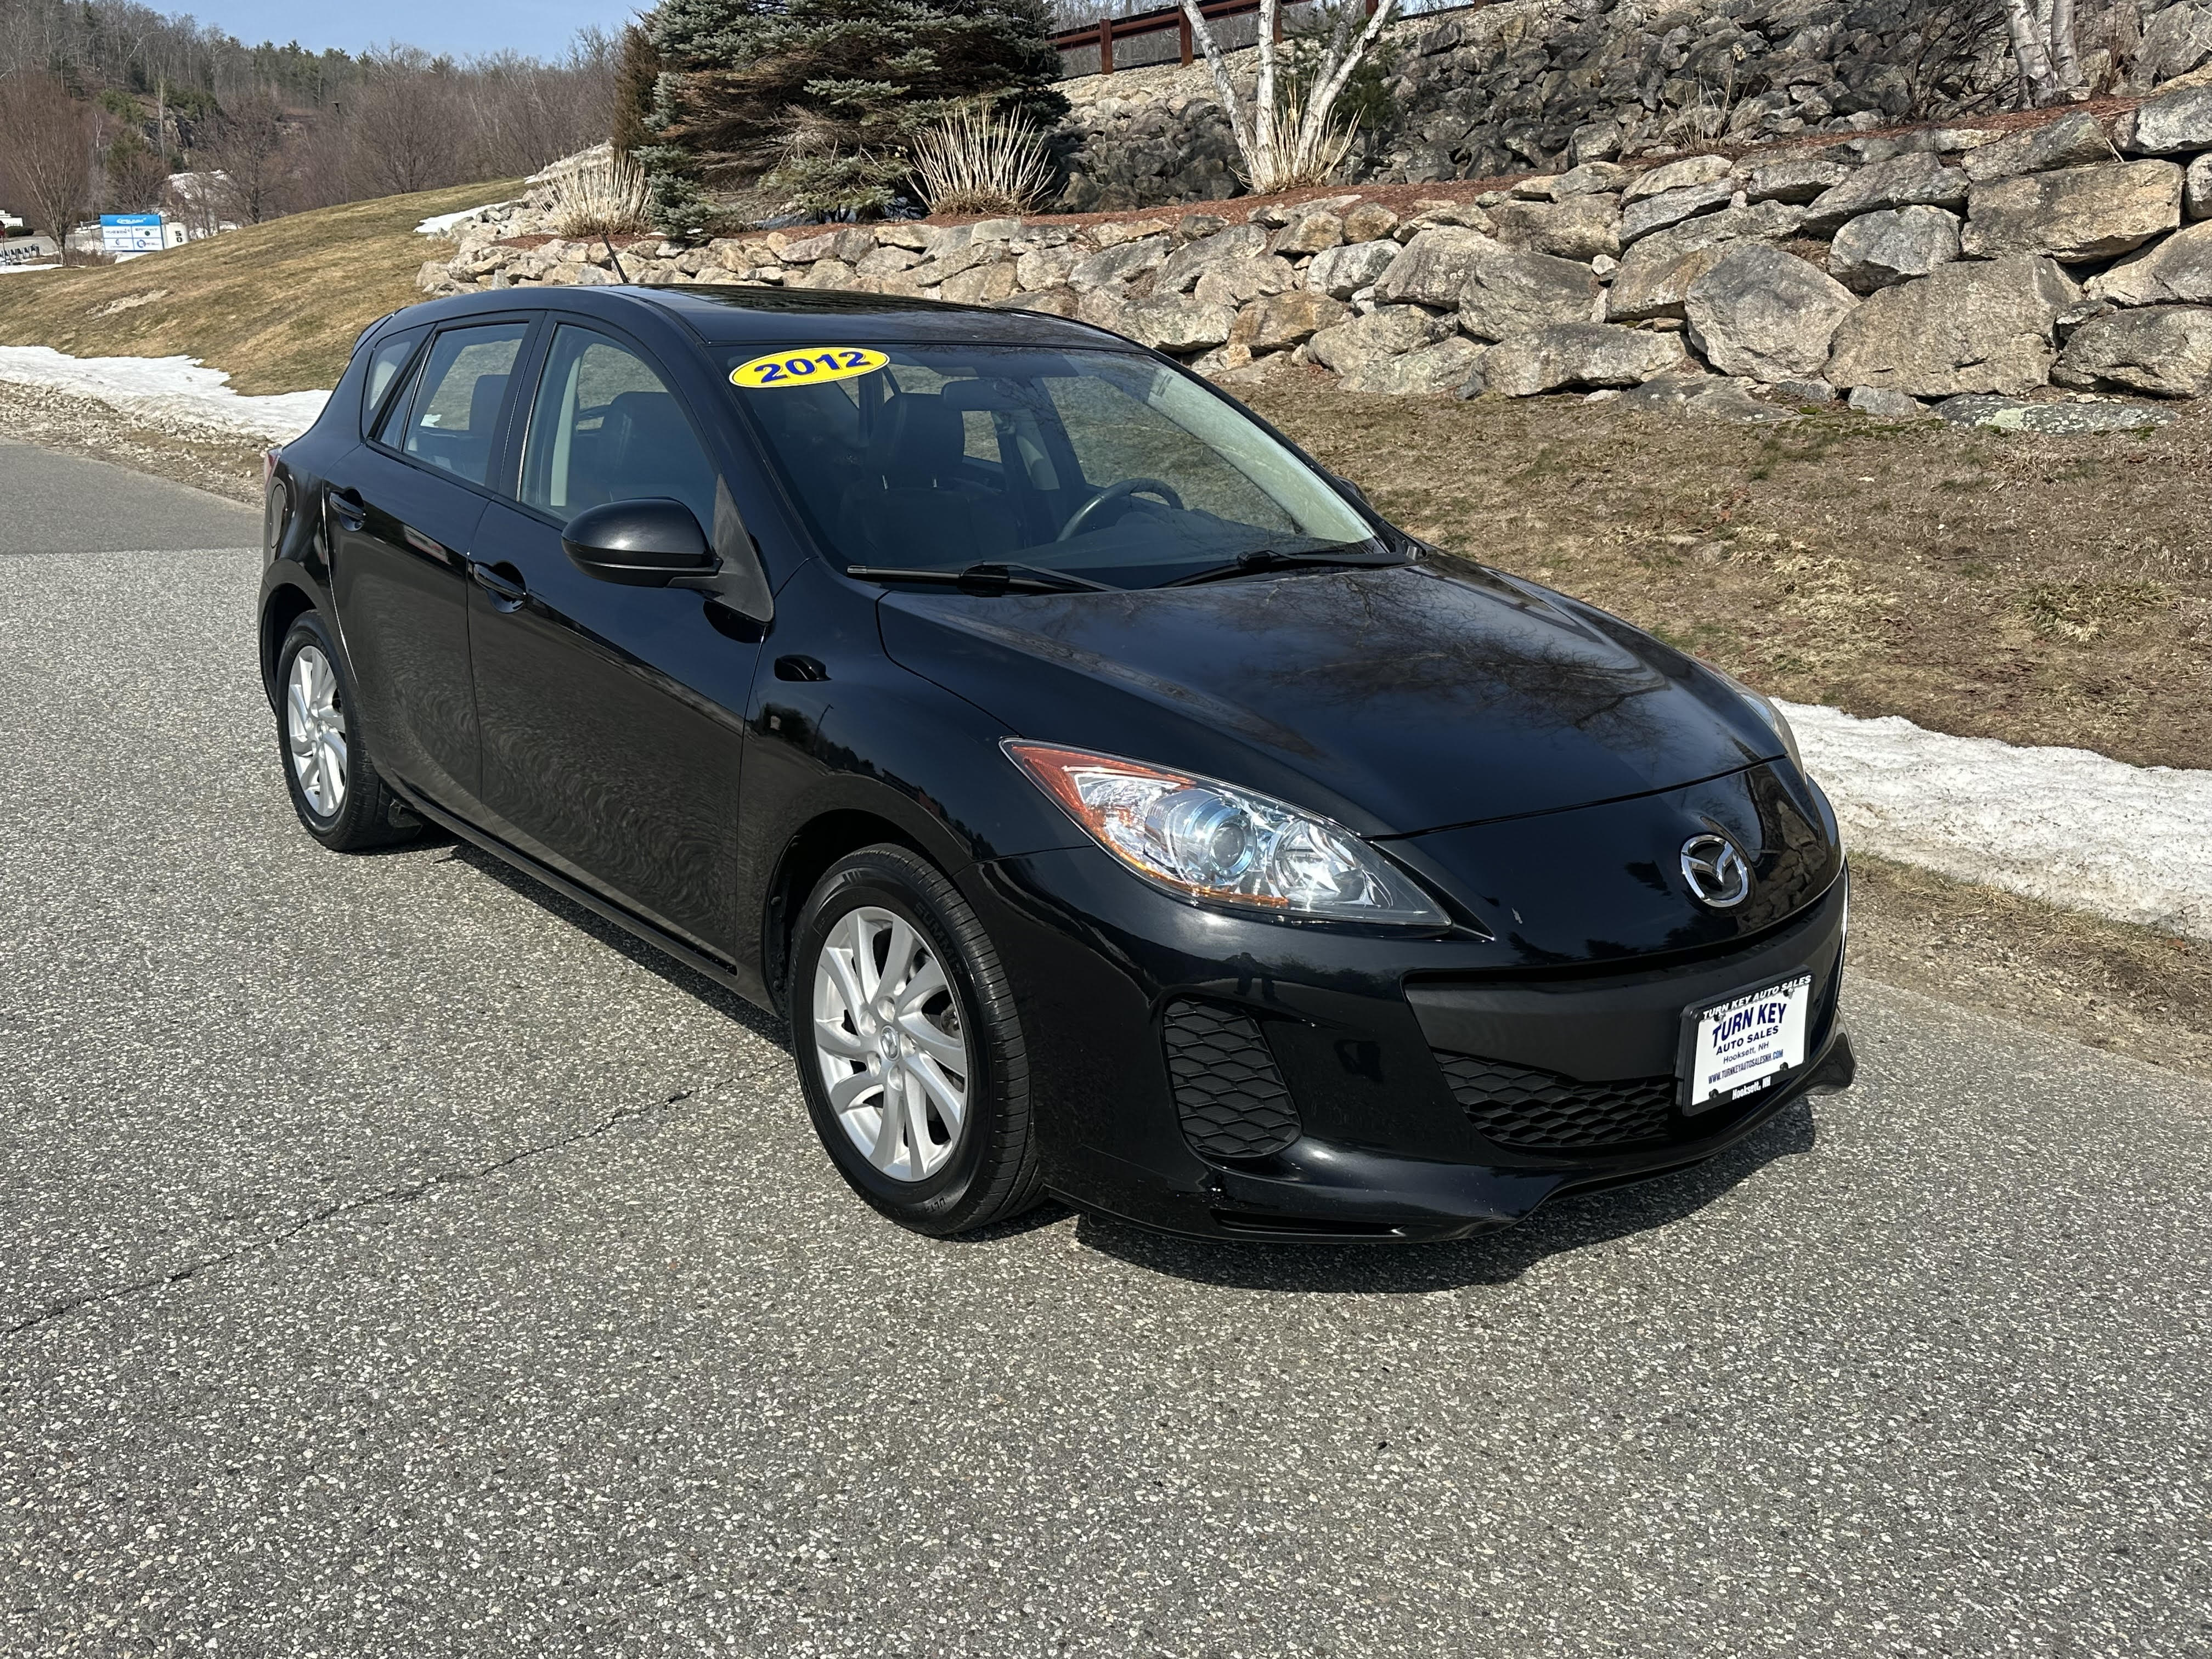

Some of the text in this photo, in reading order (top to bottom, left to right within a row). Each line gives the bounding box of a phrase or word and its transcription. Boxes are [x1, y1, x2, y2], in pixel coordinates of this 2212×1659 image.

[754, 351, 873, 383] 2012
[1703, 974, 1812, 1019] TURN KEY AUTO SALES
[1712, 1003, 1787, 1048] TURN KEY
[1716, 1025, 1779, 1055] AUTO SALES
[1758, 1041, 1769, 1051] NH
